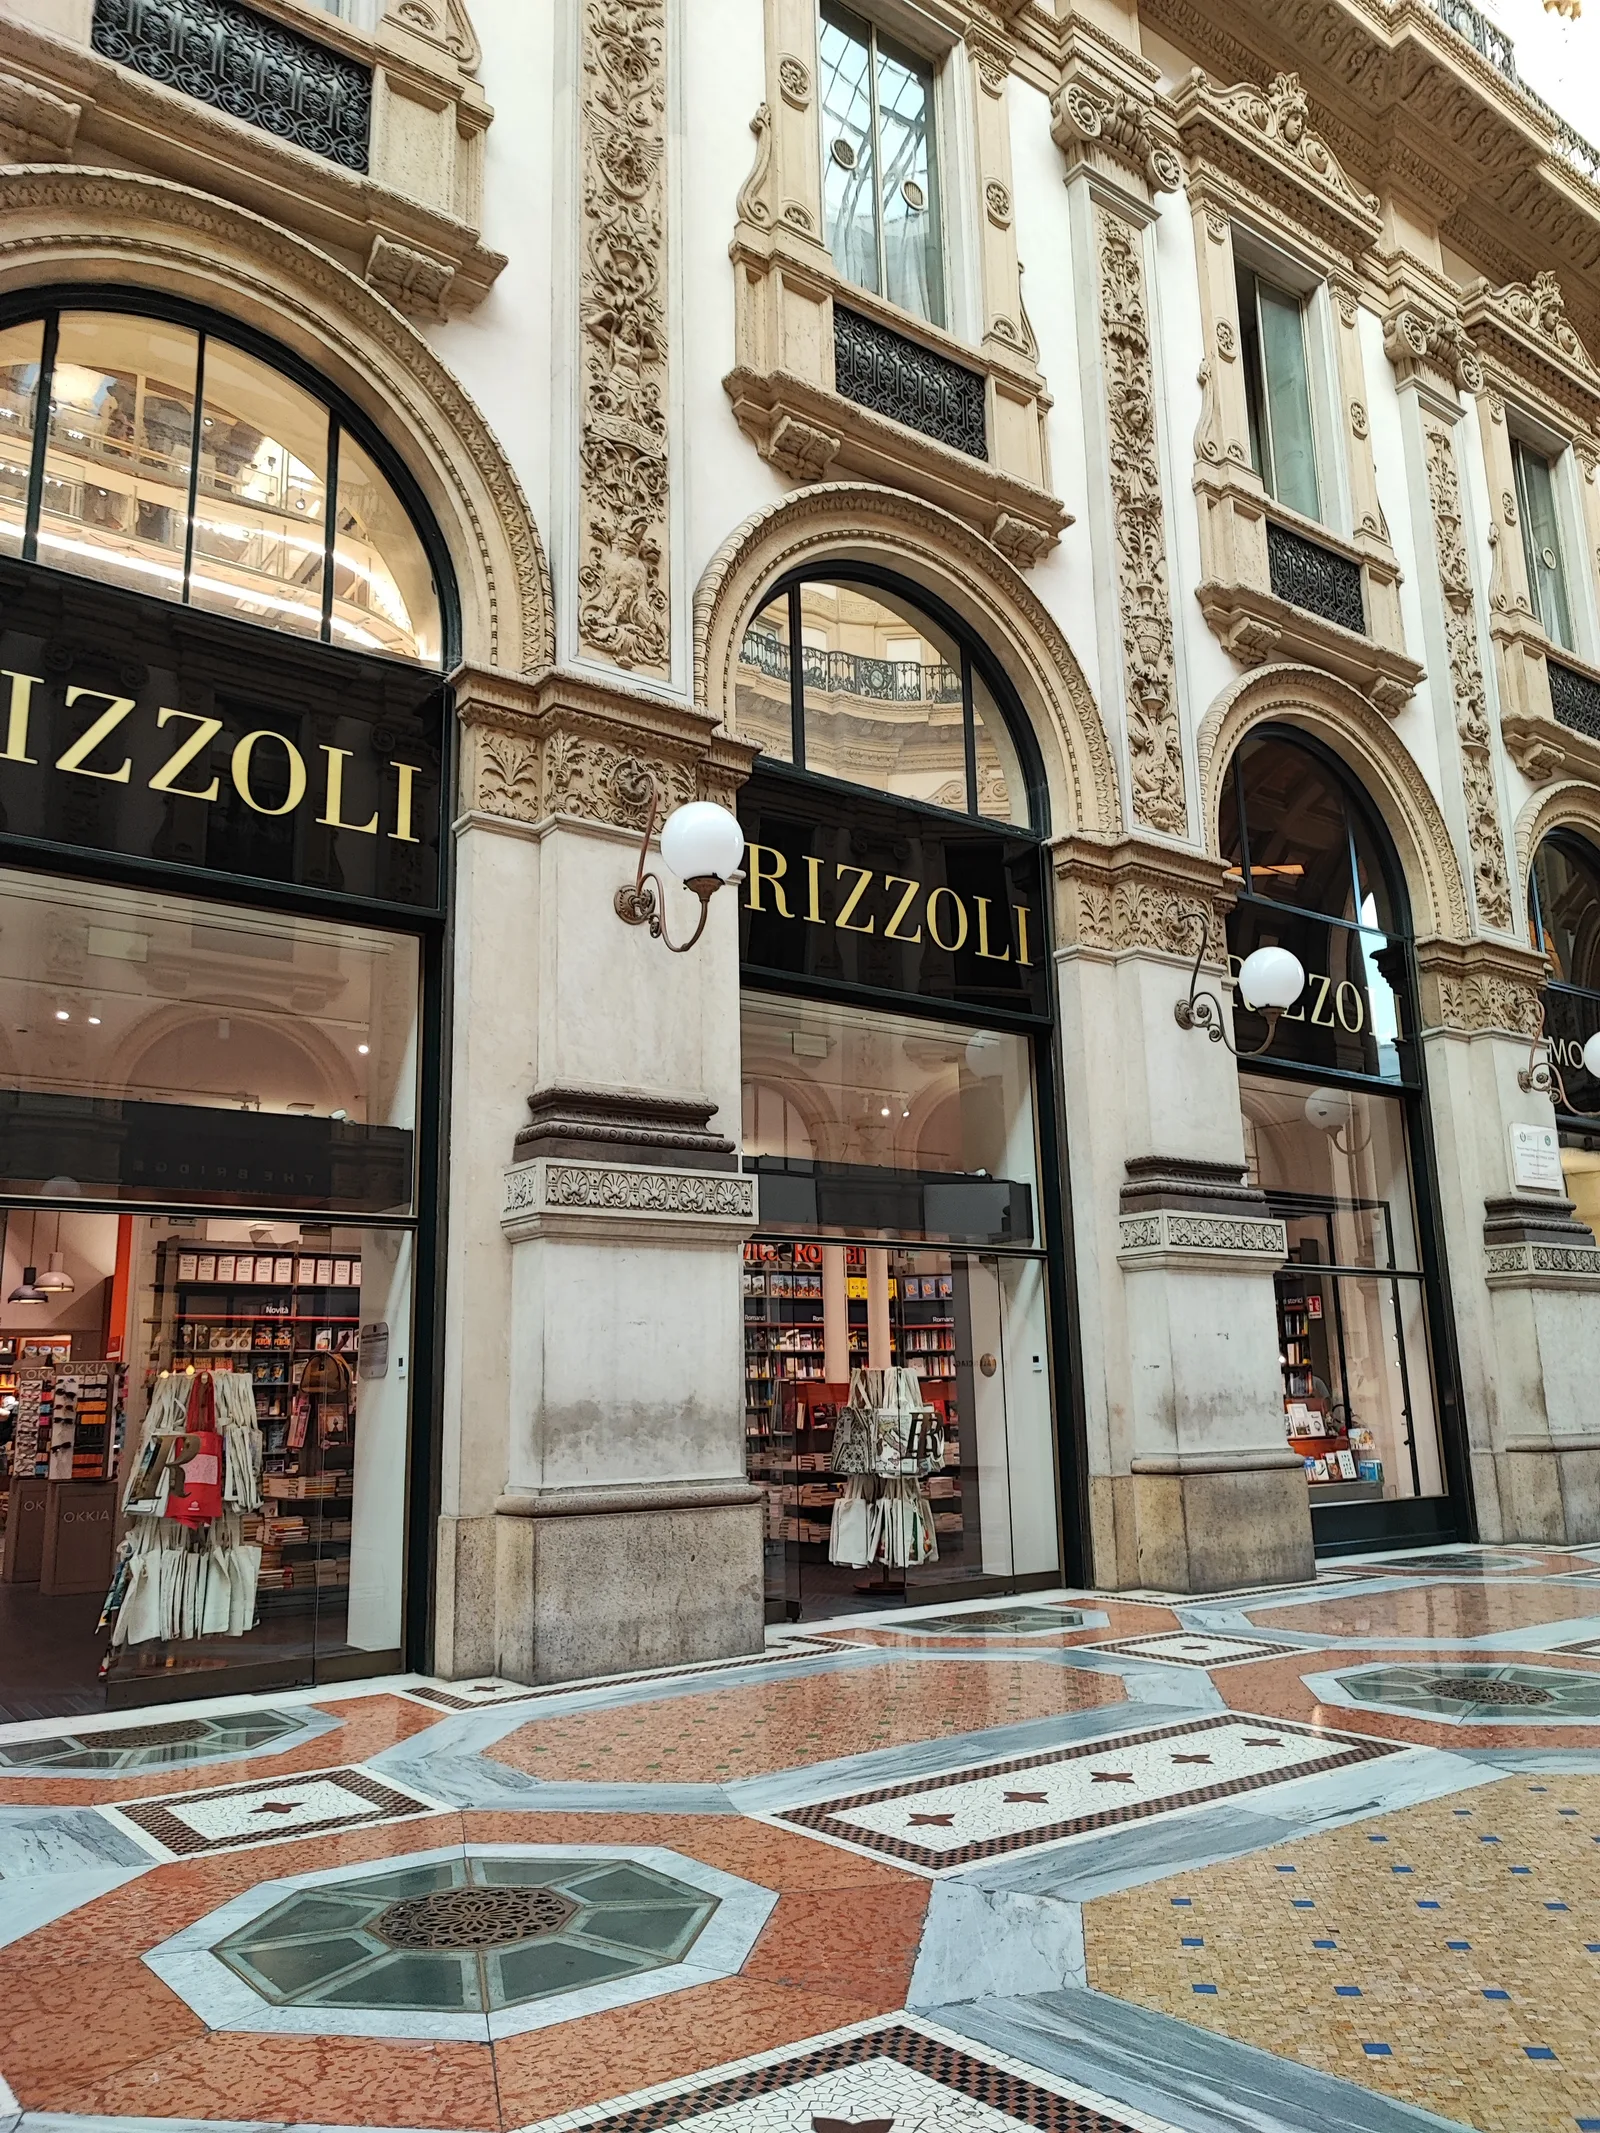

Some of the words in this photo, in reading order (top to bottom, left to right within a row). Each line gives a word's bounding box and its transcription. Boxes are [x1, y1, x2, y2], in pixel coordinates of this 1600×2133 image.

[0, 669, 421, 843] IZZOLI
[744, 843, 1034, 967] RIZZOLI
[1228, 954, 1407, 1043] RZOI
[1548, 1036, 1585, 1069] MO
[265, 1306, 289, 1314] Novità
[26, 1369, 55, 1380] OKK
[63, 1363, 109, 1375] OKKIA
[130, 1433, 203, 1500] R
[63, 1509, 110, 1523] OKKIA
